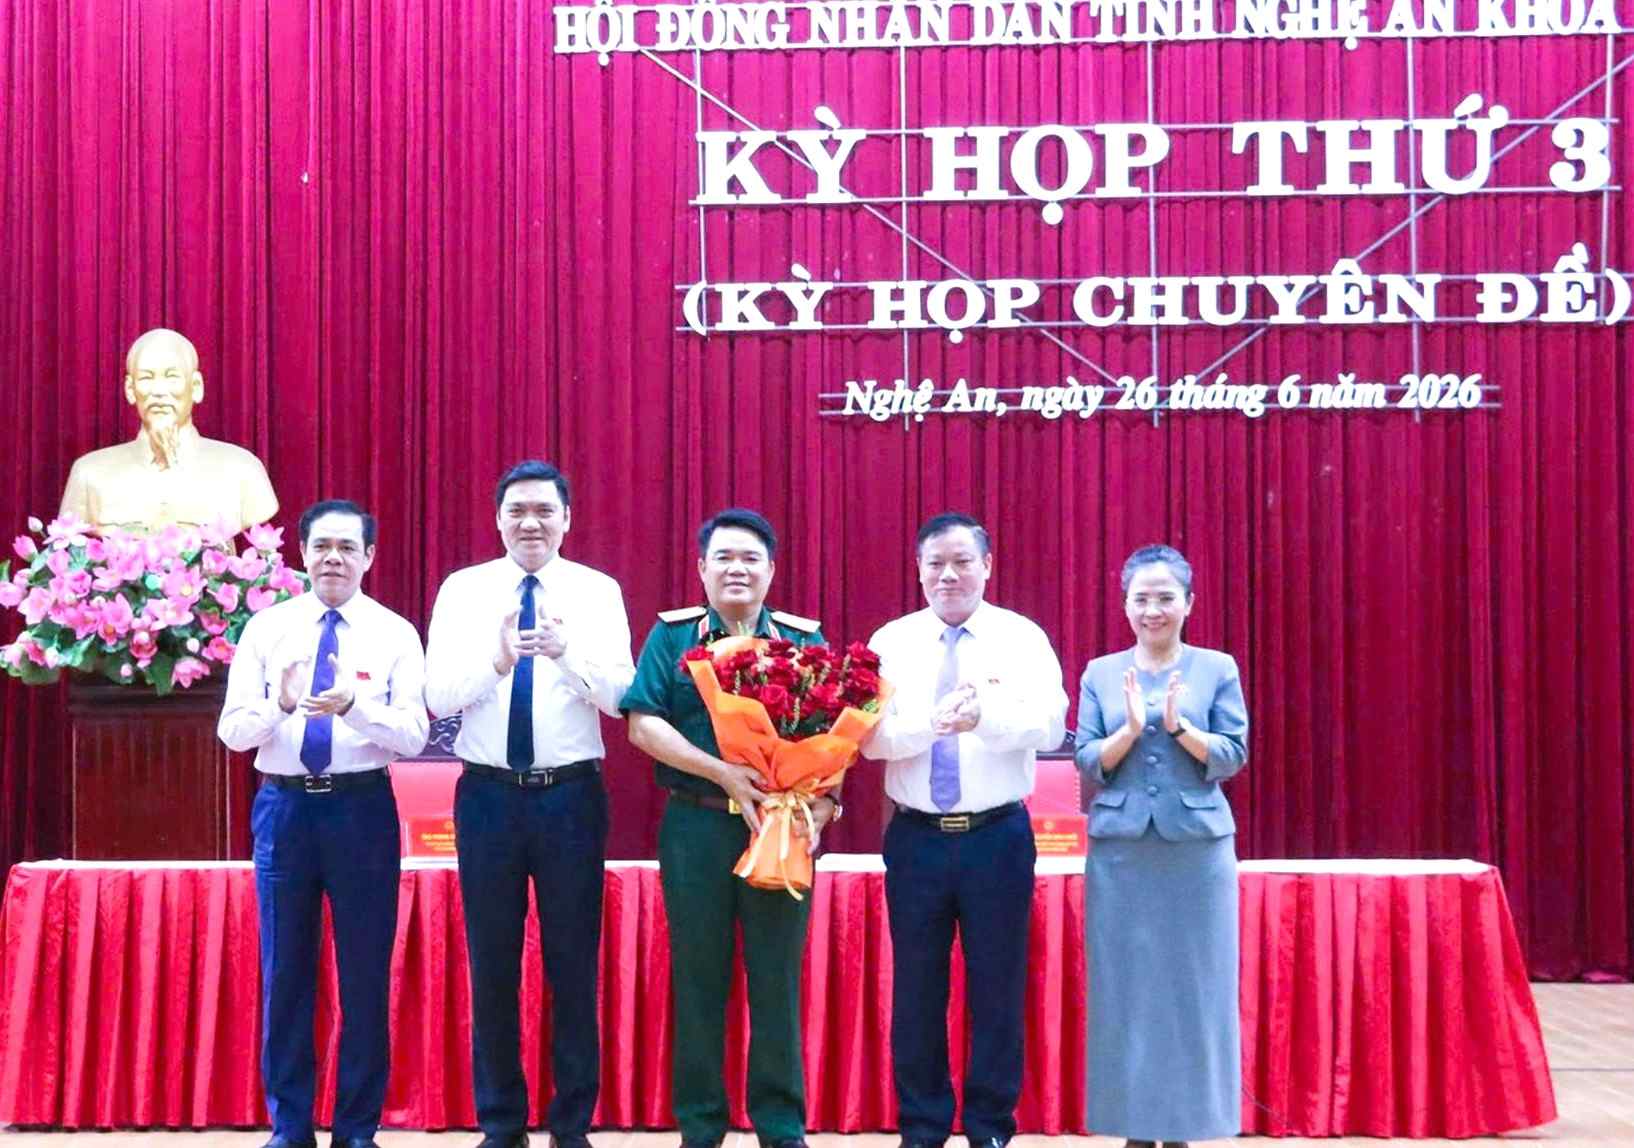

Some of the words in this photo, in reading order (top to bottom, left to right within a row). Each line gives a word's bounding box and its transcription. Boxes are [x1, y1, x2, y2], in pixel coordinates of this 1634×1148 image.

[697, 106, 866, 203] KỲ
[923, 123, 1170, 226] HỌP
[1231, 93, 1508, 196] THỨ
[1549, 117, 1612, 192] 3
[682, 263, 833, 336] (KỲ
[867, 278, 1040, 344] HỌP
[1073, 258, 1442, 326] CHUYÊN
[1475, 242, 1632, 326] ĐỀ)
[842, 378, 934, 422] Nghệ
[942, 378, 1007, 417] An,
[1020, 376, 1105, 419] ngày
[1114, 376, 1158, 411] 26
[1169, 373, 1269, 418] tháng
[1277, 374, 1301, 409] 6
[1308, 373, 1387, 409] năm
[1397, 373, 1482, 409] 2026
